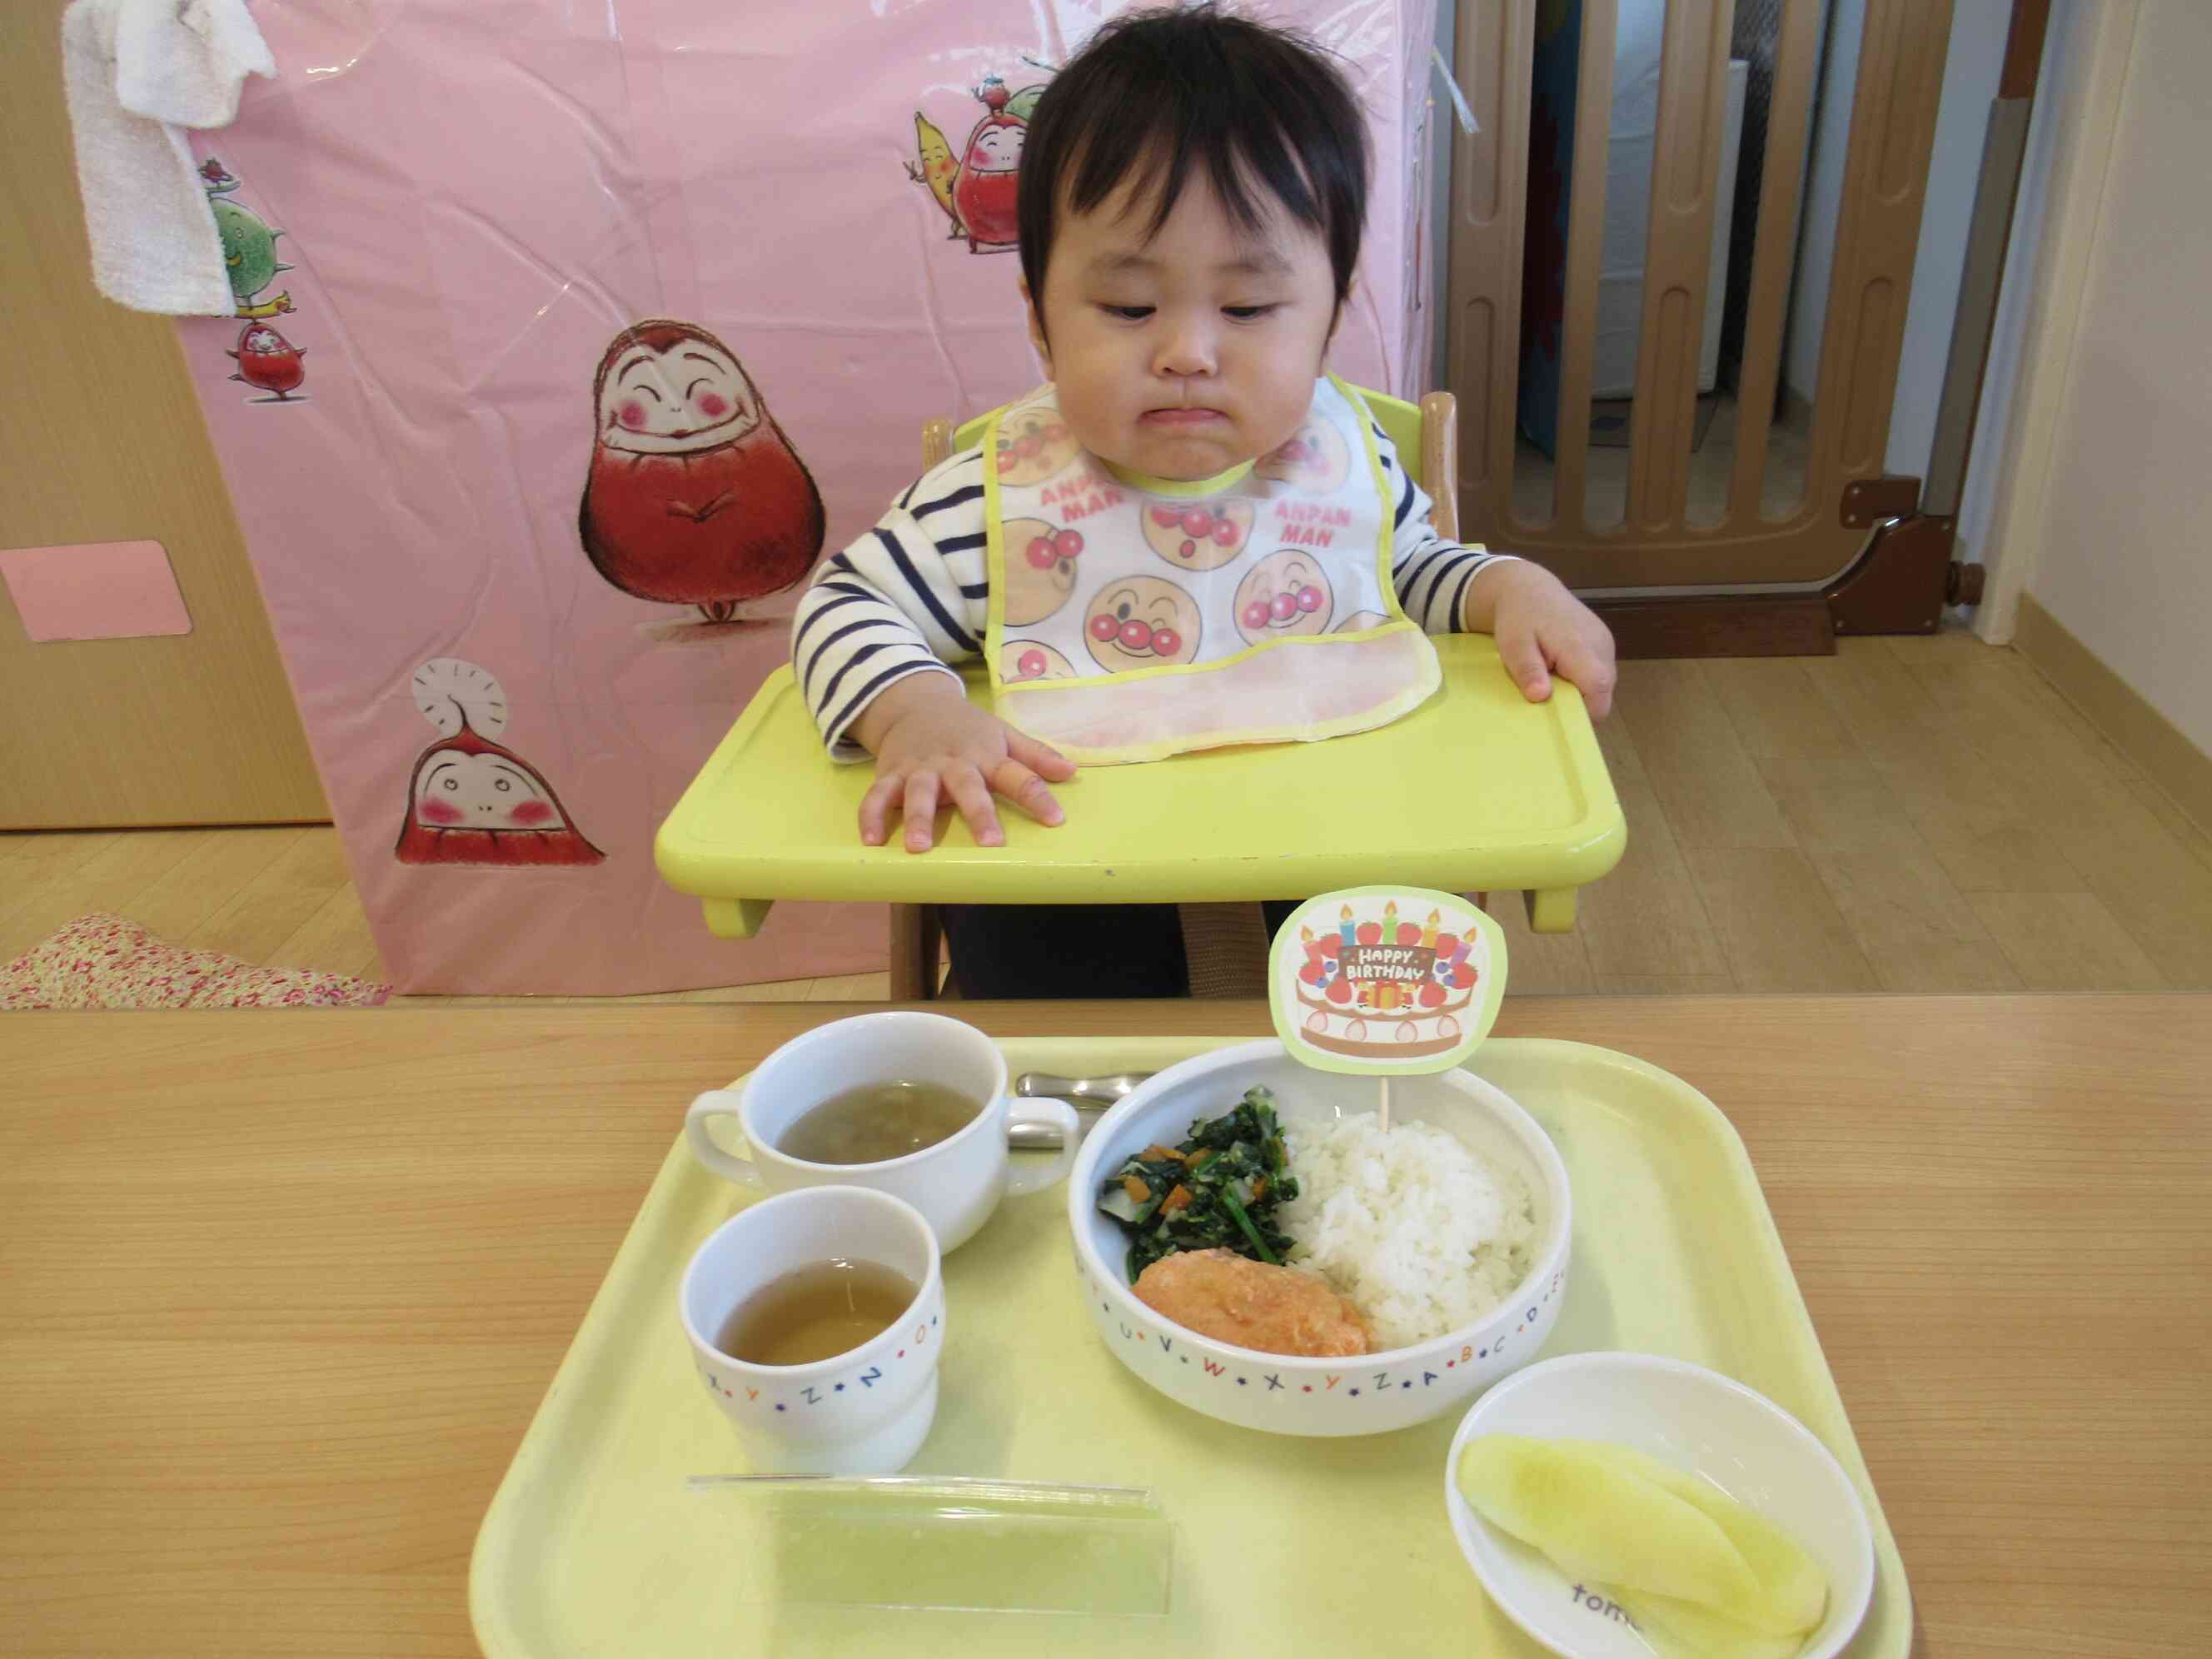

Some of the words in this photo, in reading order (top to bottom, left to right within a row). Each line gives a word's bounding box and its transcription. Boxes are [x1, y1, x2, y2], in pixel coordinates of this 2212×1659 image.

[1062, 486, 1122, 522] MAN
[1273, 500, 1353, 526] ANPAN
[1279, 522, 1333, 546] MAN
[1358, 949, 1413, 965] HAPPY
[1346, 964, 1425, 980] BIRTHDAY
[1159, 1334, 1172, 1352] V
[1203, 1357, 1226, 1378] W
[1263, 1373, 1285, 1390] X
[1325, 1374, 1340, 1389] Y
[1373, 1373, 1392, 1390] Z
[1423, 1371, 1437, 1386] A
[1461, 1345, 1472, 1363] B
[1493, 1335, 1506, 1353] C
[800, 1387, 822, 1404] Z
[1572, 1583, 1644, 1632] tom
